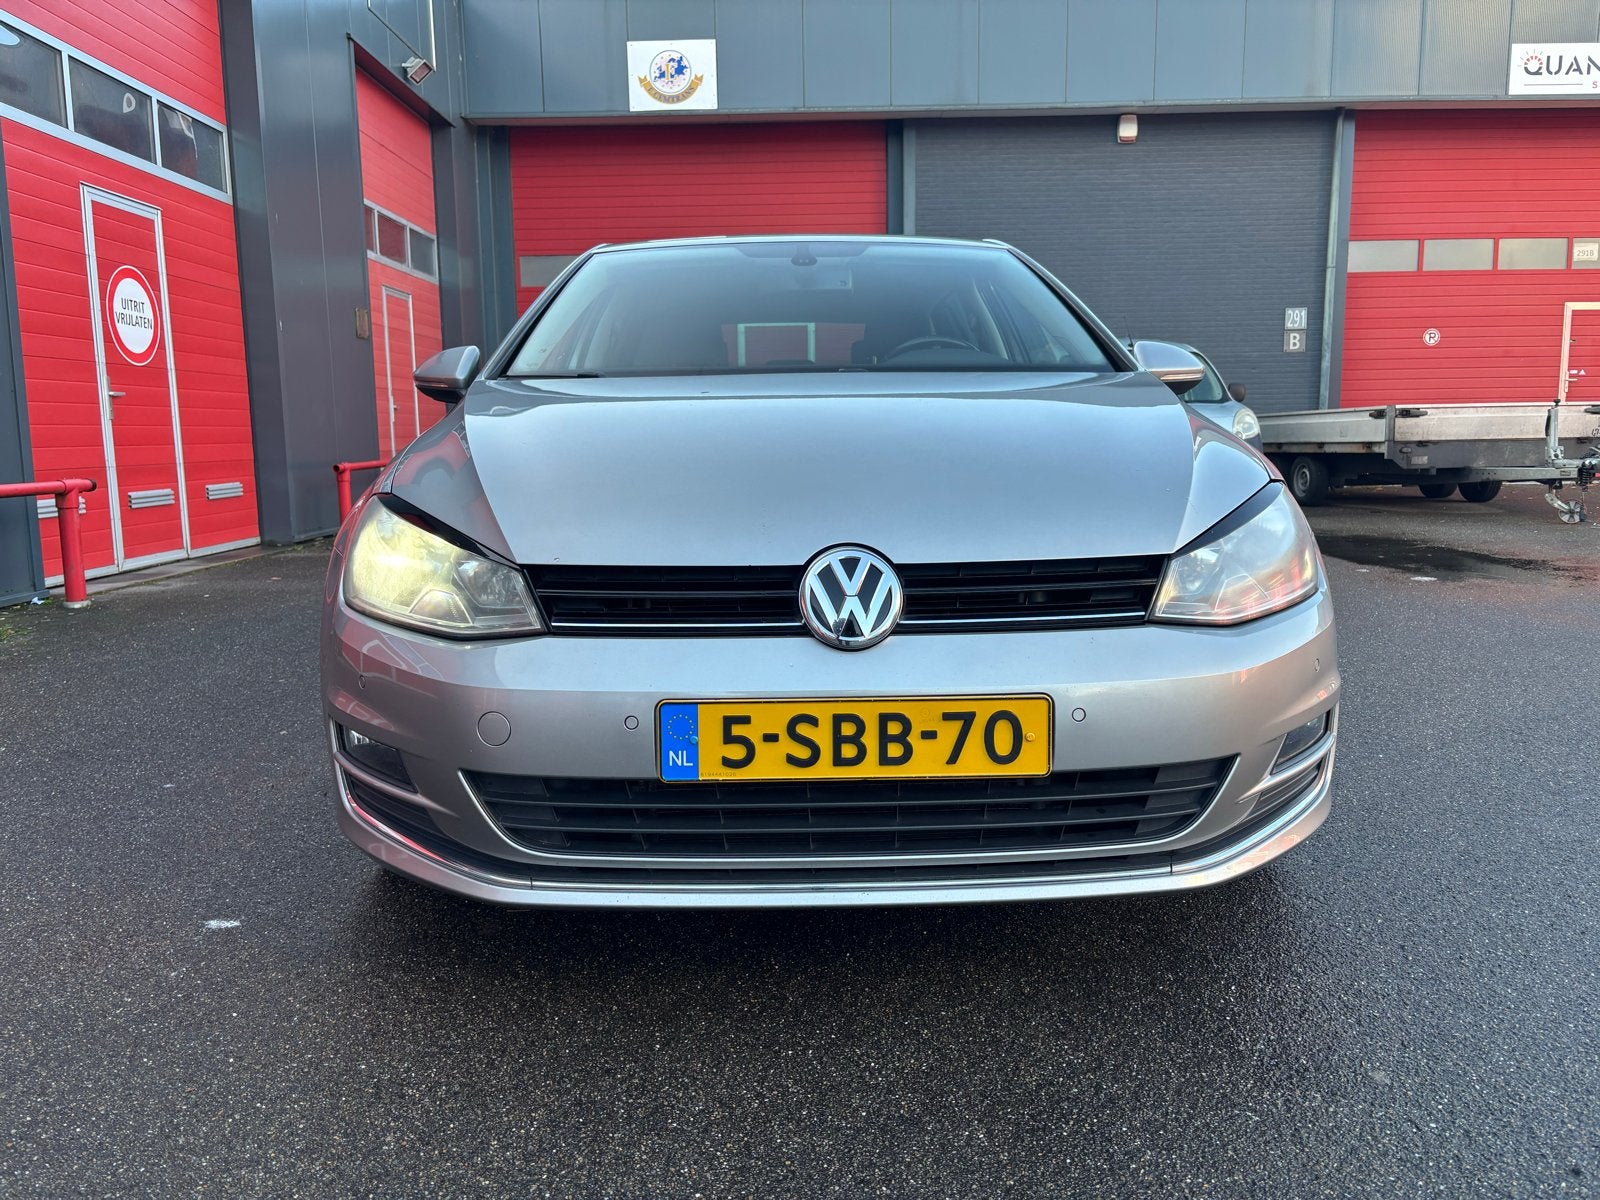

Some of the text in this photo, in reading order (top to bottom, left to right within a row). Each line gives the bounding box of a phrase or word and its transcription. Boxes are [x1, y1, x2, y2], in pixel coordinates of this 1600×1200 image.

[121, 298, 145, 313] UITRIT
[115, 311, 153, 330] VRIJLATEN
[1287, 310, 1305, 327] 291
[1289, 333, 1300, 349] B
[721, 709, 1024, 769] 5-SBB-70
[668, 750, 694, 766] NL
